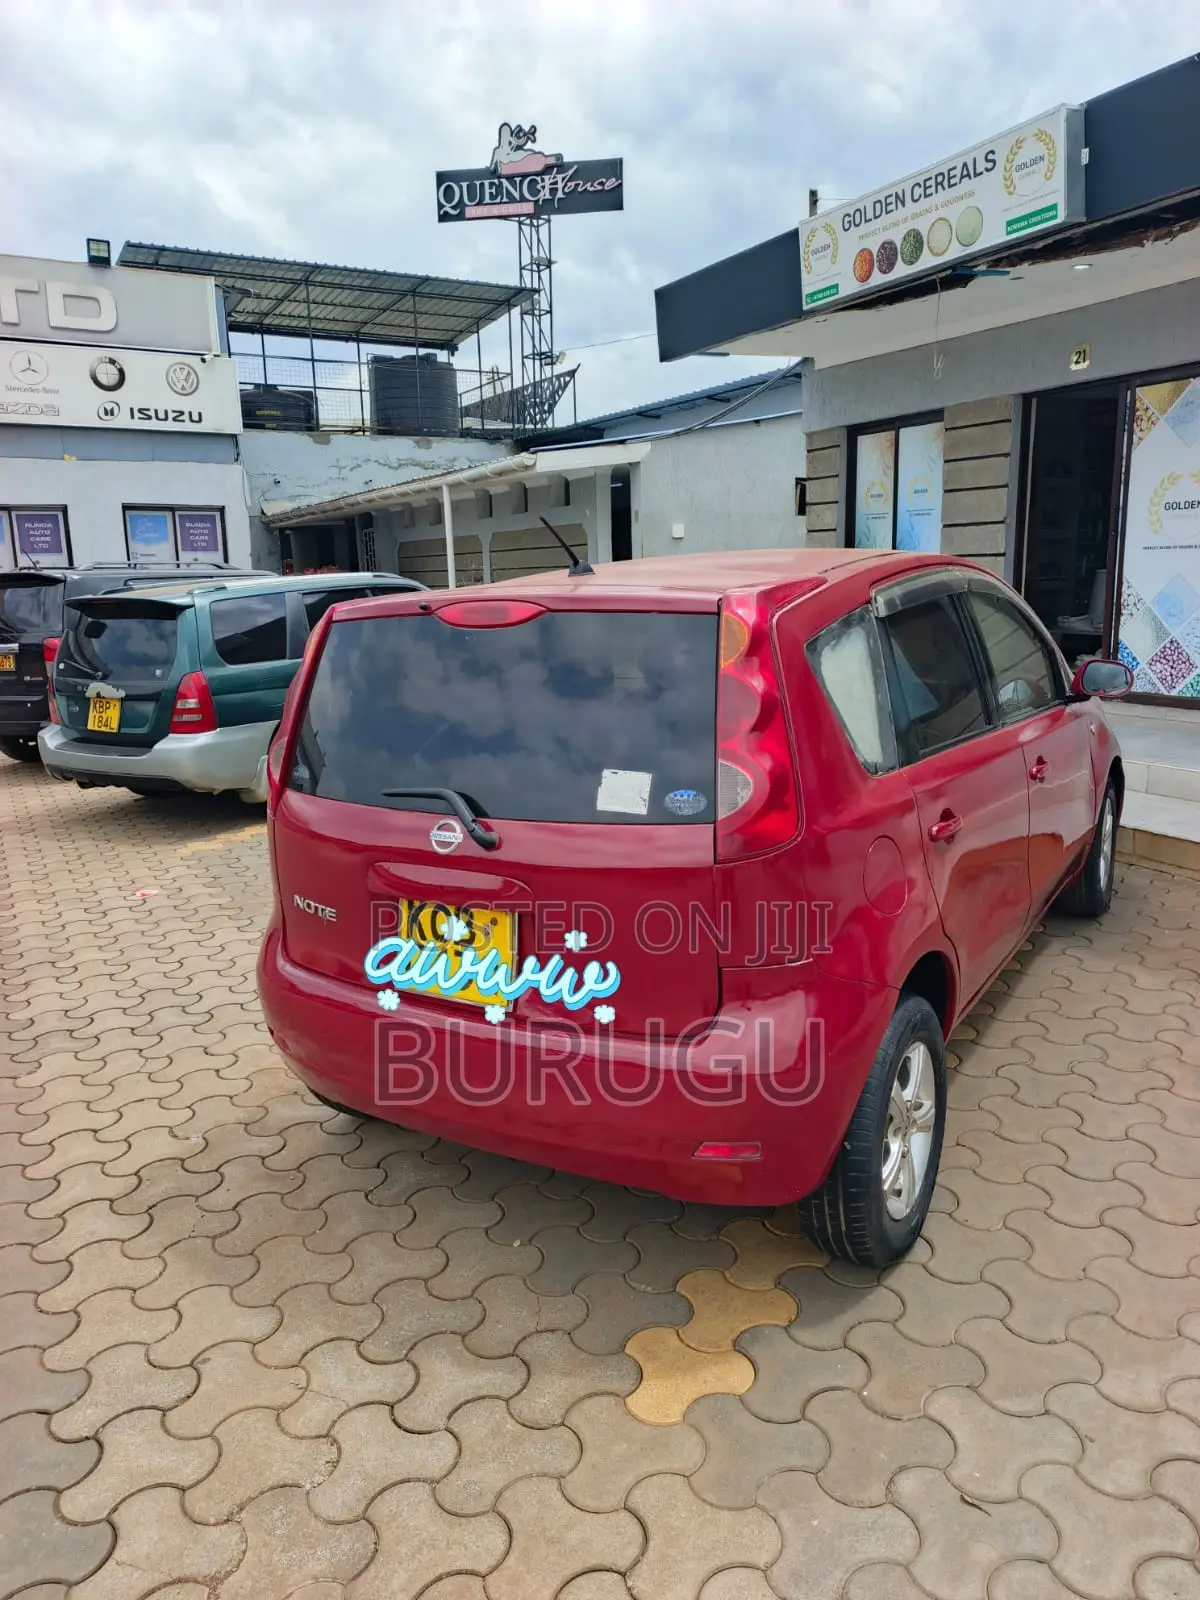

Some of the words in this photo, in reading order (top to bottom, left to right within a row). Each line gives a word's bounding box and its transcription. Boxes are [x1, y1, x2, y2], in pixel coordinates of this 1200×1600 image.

[1015, 154, 1045, 173] GOLDEN
[538, 165, 622, 208] House
[842, 188, 906, 232] GOLDEN
[911, 149, 997, 203] CEREALS
[940, 188, 976, 208] GOODNESS
[810, 243, 831, 257] GOLDEN
[1074, 349, 1086, 365] 21
[129, 407, 203, 424] ISUZU
[92, 700, 111, 714] KBP
[92, 715, 115, 731] 184L
[432, 832, 463, 842] NISSAN
[293, 894, 337, 922] NOTE
